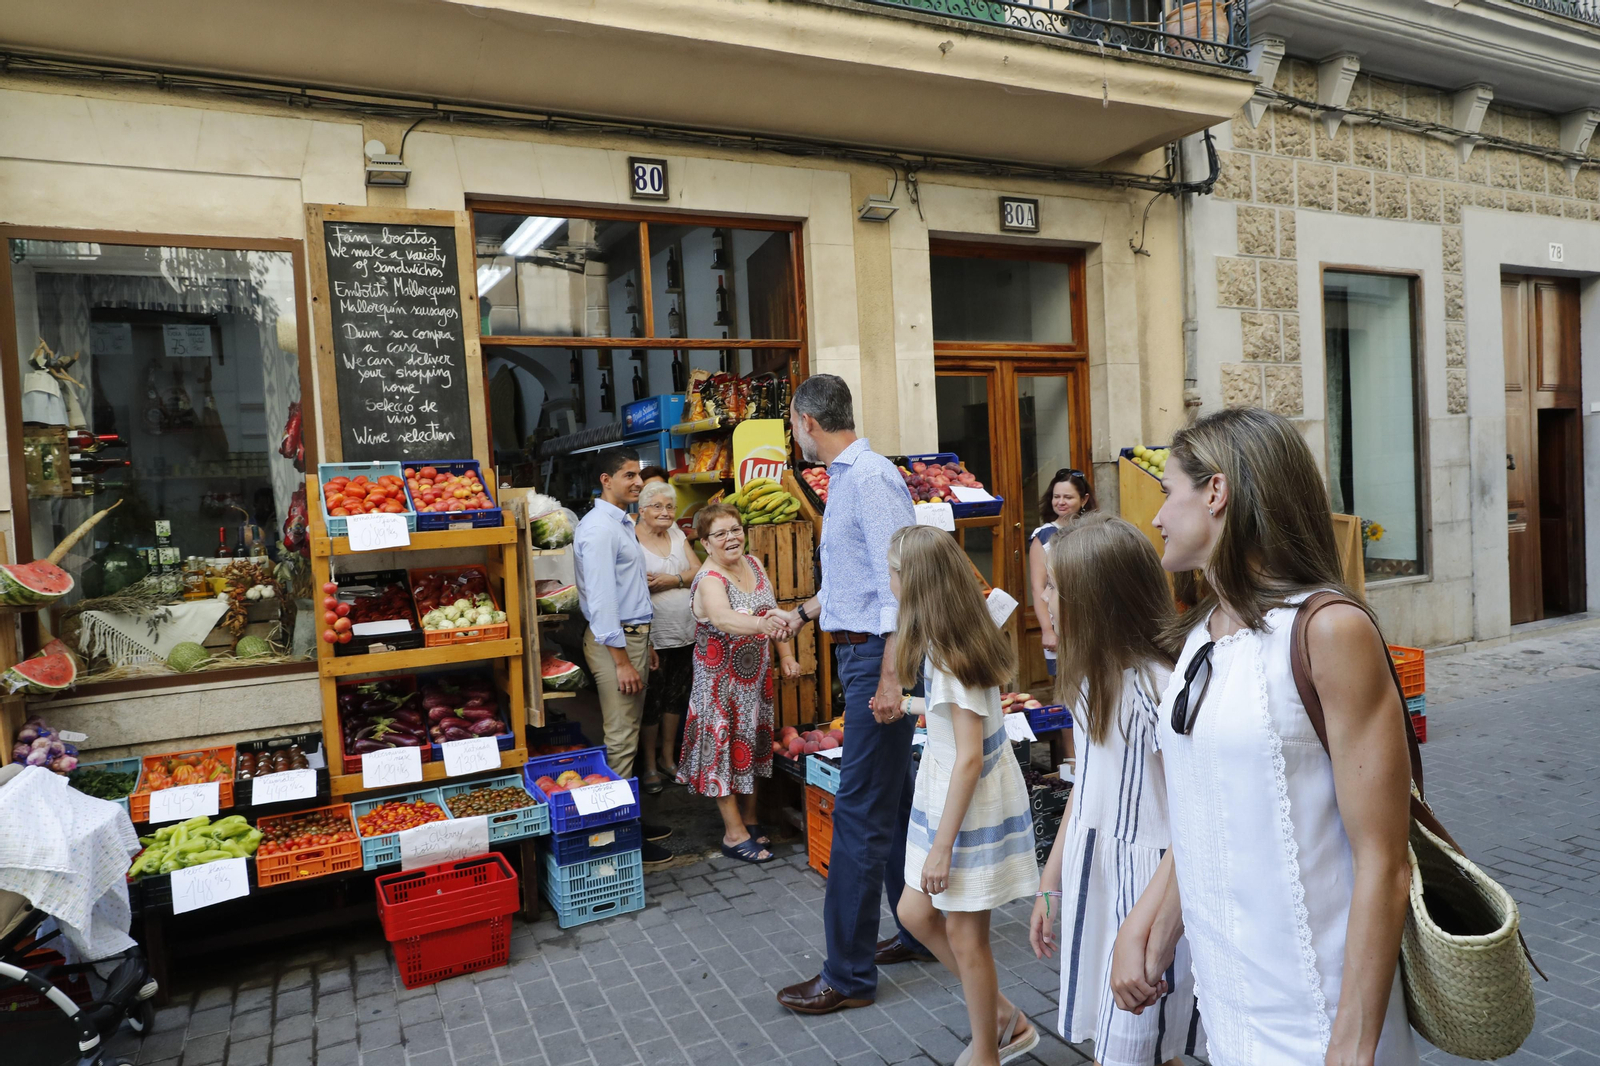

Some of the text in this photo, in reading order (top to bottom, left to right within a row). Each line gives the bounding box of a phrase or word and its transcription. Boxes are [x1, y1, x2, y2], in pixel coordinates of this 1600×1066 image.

[635, 166, 663, 192] 80
[381, 227, 436, 244] bocatas
[328, 242, 446, 268] We make a variety
[1550, 245, 1562, 259] 78
[352, 258, 443, 278] of sandwiches
[410, 306, 458, 326] sausages
[389, 330, 408, 338] sa
[412, 328, 455, 348] compra
[362, 342, 427, 354] a casa
[342, 353, 454, 370] We can deliver
[358, 366, 452, 388] your shopping
[382, 380, 420, 394] home
[419, 400, 438, 412] de
[387, 412, 416, 424] vins
[352, 421, 455, 444] Wine selection
